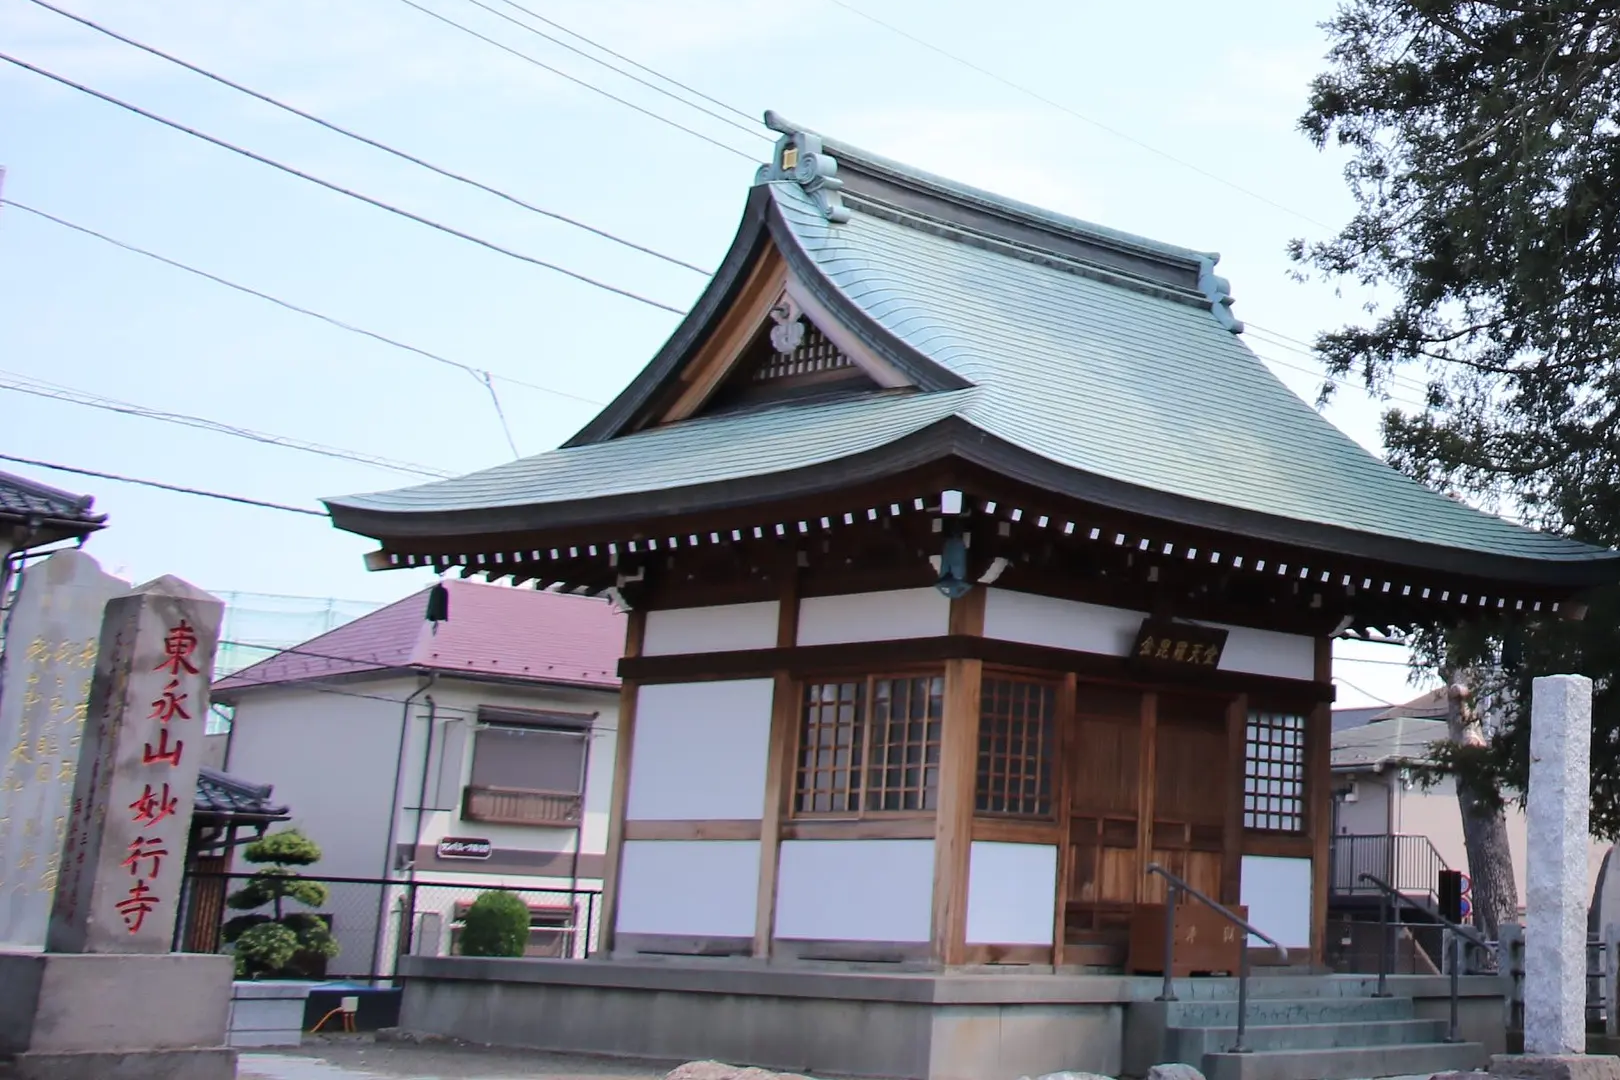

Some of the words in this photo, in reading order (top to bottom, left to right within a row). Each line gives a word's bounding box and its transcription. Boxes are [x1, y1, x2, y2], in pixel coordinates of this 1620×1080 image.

[115, 620, 199, 934] 東永山妙行寺
